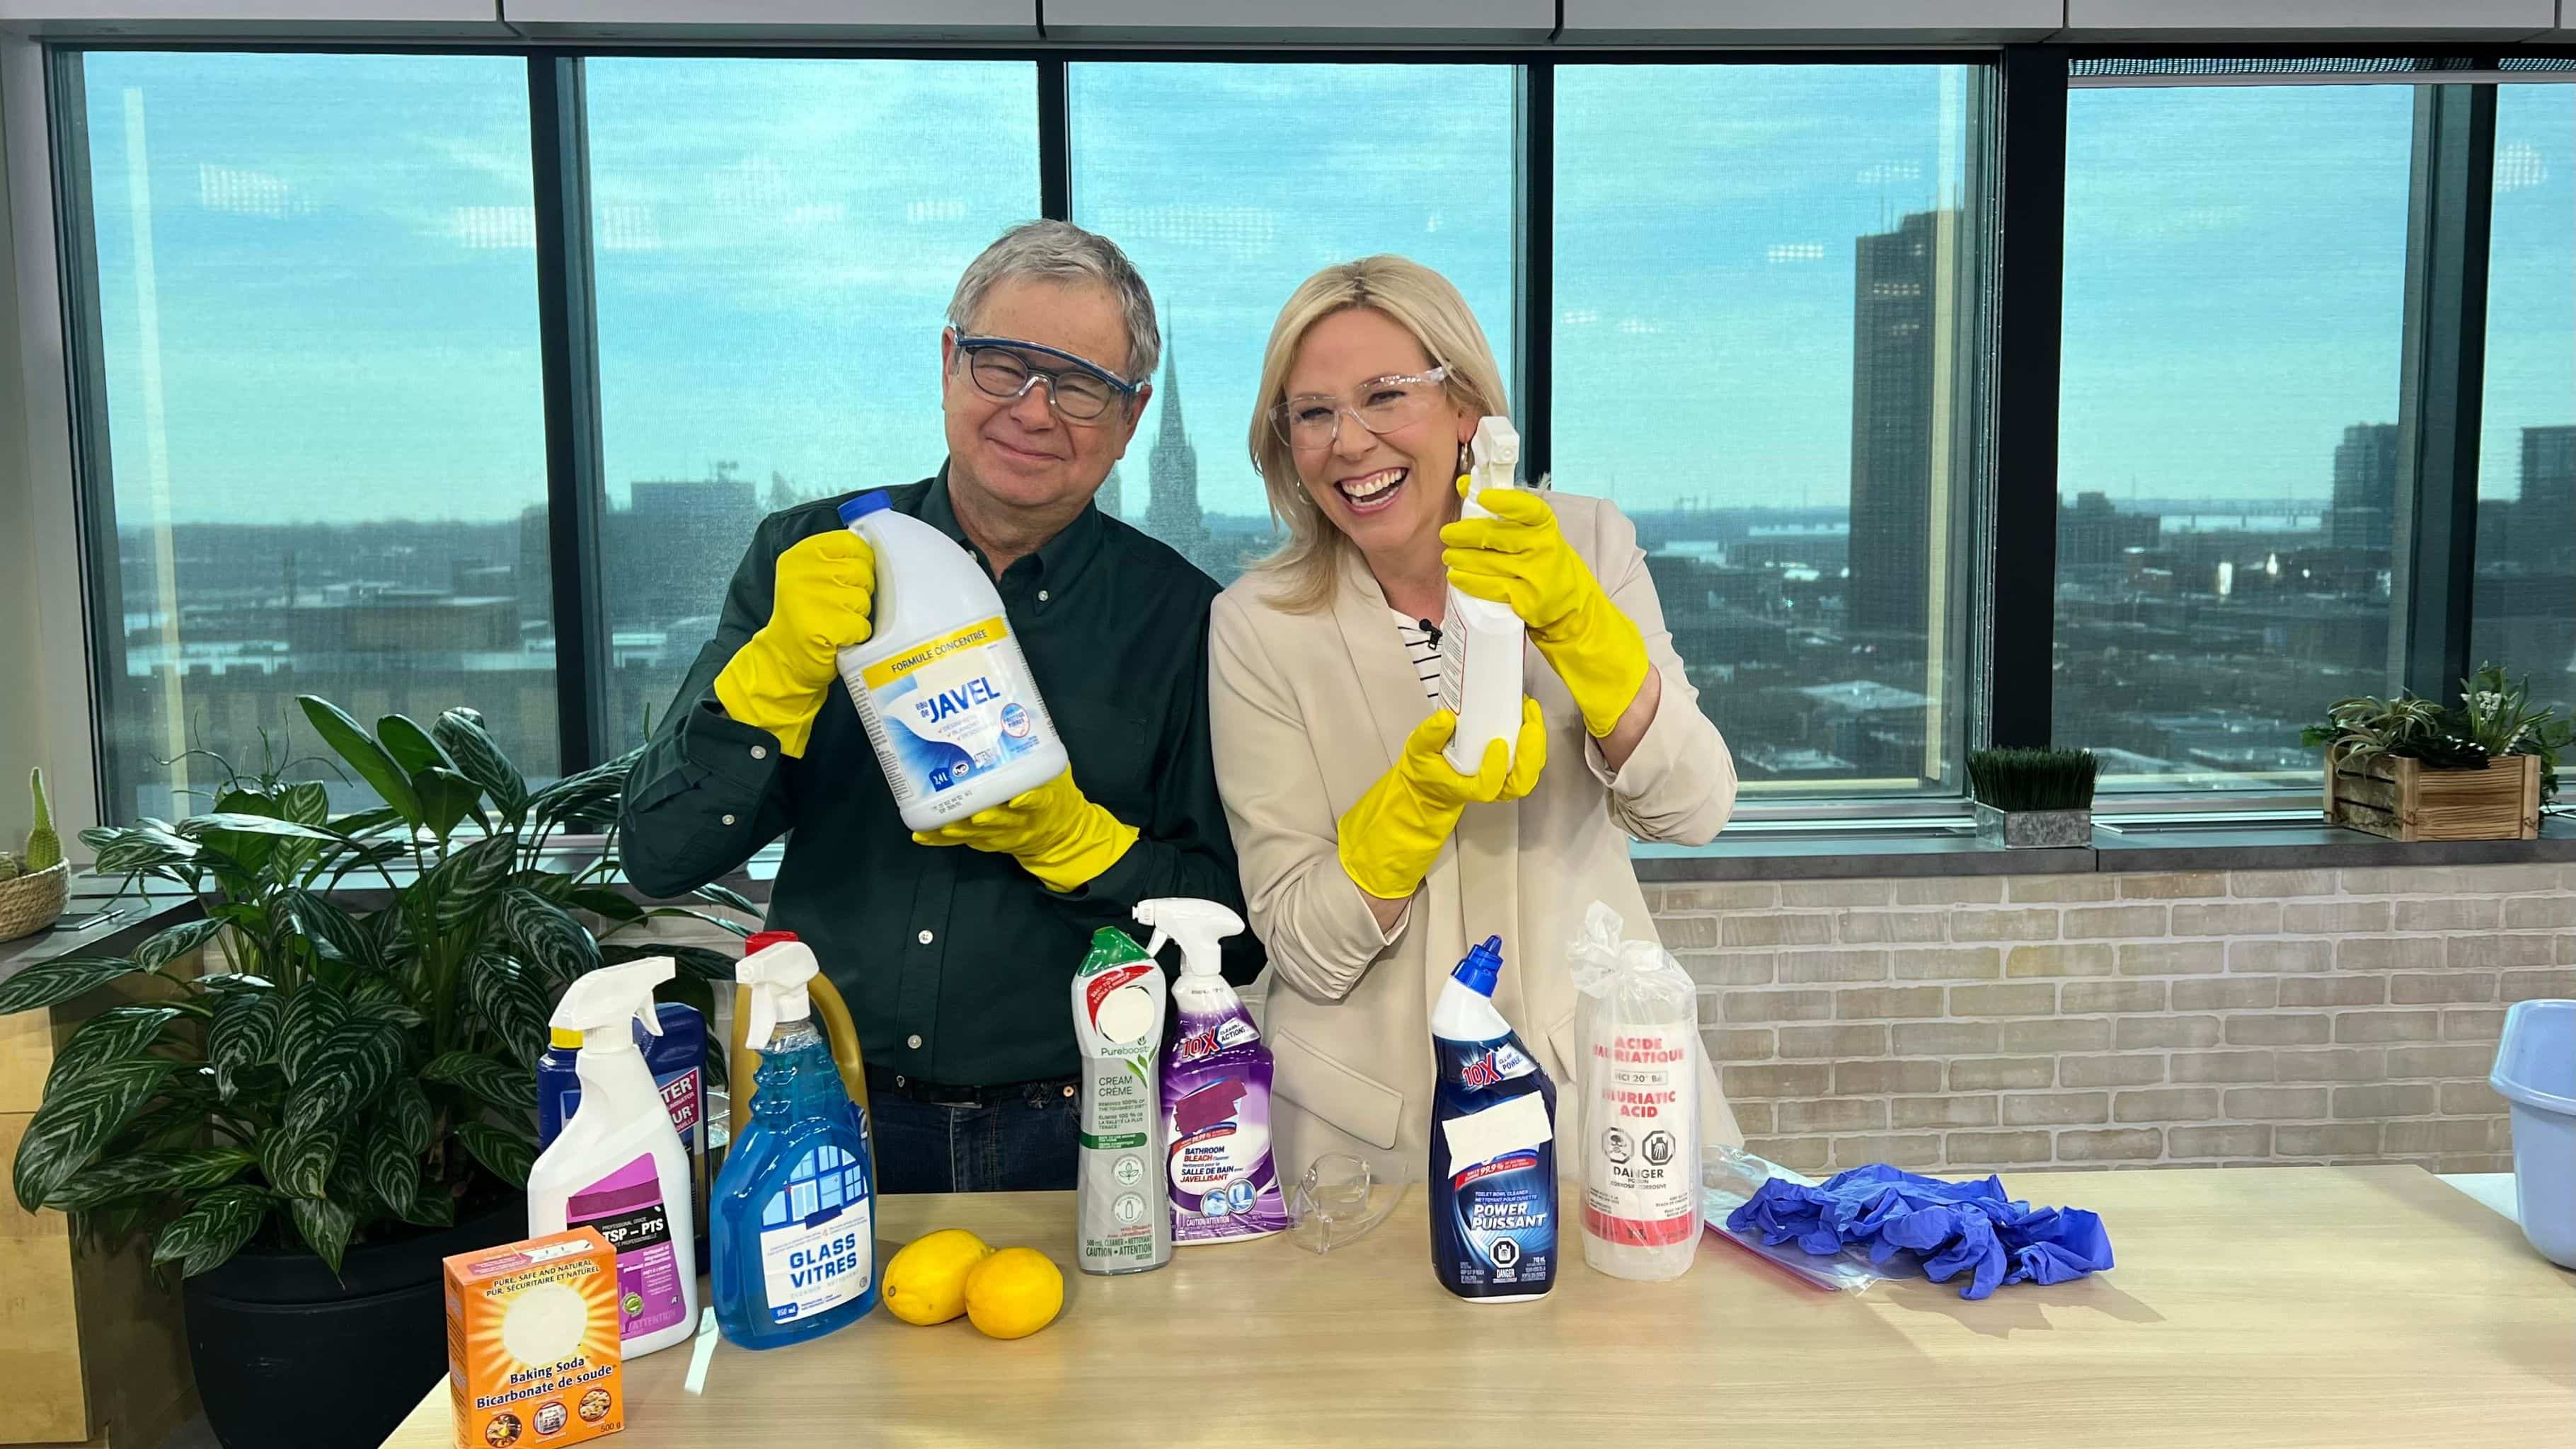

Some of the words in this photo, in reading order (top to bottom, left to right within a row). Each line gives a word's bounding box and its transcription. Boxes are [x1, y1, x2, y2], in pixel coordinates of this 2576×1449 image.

[891, 650, 935, 673] FORMULE
[934, 628, 988, 656] CONCENTRÉE
[928, 676, 1001, 723] JAVEL
[1182, 1025, 1221, 1058] 10X
[1614, 1037, 1662, 1050] ACIDE
[1101, 1046, 1148, 1056] Pureboost
[1461, 1052, 1502, 1087] 10X
[1098, 1075, 1132, 1086] CREAM
[1098, 1085, 1132, 1097] CRÈME
[1602, 1090, 1676, 1104] MURIATIC
[1621, 1105, 1658, 1118] ACID
[1185, 1146, 1225, 1155] BATHROOM
[1180, 1174, 1229, 1183] JAVELLISANT
[1614, 1166, 1664, 1179] DANGER
[1473, 1203, 1528, 1216] POWER
[1471, 1213, 1546, 1230] PUISSANT
[602, 1228, 627, 1242] TSP
[641, 1218, 664, 1235] PTS
[789, 1232, 856, 1269] GLASS
[1086, 1247, 1112, 1257] CAUTION
[1119, 1243, 1152, 1256] ATTENTION
[519, 1272, 537, 1282] SAFE
[539, 1268, 556, 1276] AND
[558, 1259, 592, 1272] NATURAL
[790, 1252, 857, 1288] VITRES
[1496, 1269, 1515, 1278] DANGER
[507, 1276, 555, 1293] SÉCURITAIRE
[566, 1266, 600, 1278] NATUREL
[510, 1366, 553, 1384] Baking
[556, 1357, 585, 1373] Soda
[476, 1382, 555, 1409] Bicarbonate
[558, 1375, 573, 1388] de
[576, 1365, 612, 1383] soude
[601, 1423, 614, 1433] 500
[616, 1421, 621, 1430] g
